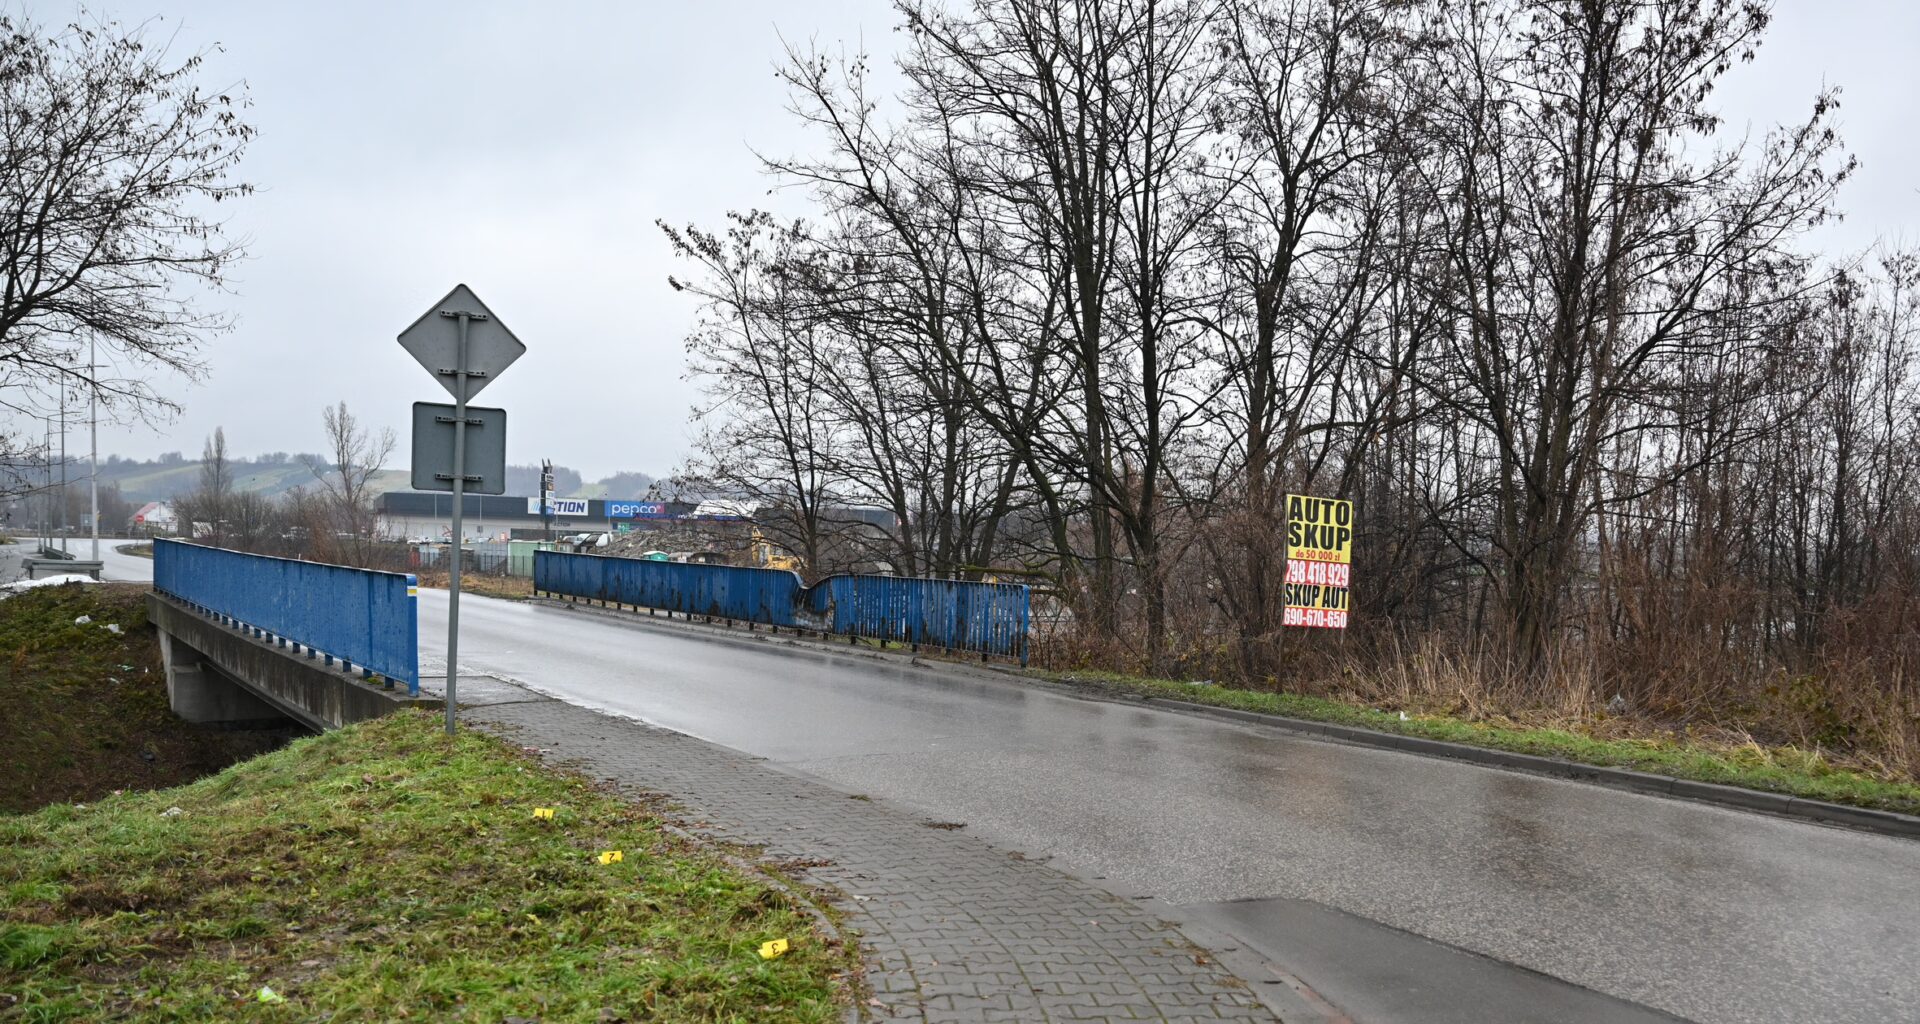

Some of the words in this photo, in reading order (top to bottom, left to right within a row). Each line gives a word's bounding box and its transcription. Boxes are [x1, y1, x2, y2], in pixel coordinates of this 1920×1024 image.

[611, 504, 657, 516] pepco
[1289, 496, 1350, 526] AUTO
[1288, 522, 1351, 551] SKUP
[1295, 549, 1304, 558] do
[1306, 550, 1316, 559] 50
[1318, 551, 1333, 560] 000
[1286, 559, 1306, 583] 798
[1307, 562, 1326, 584] 418
[1327, 563, 1349, 586] 929
[1285, 582, 1320, 607] SKUP
[1321, 586, 1349, 609] AUT
[1284, 607, 1347, 628] 690-670-650
